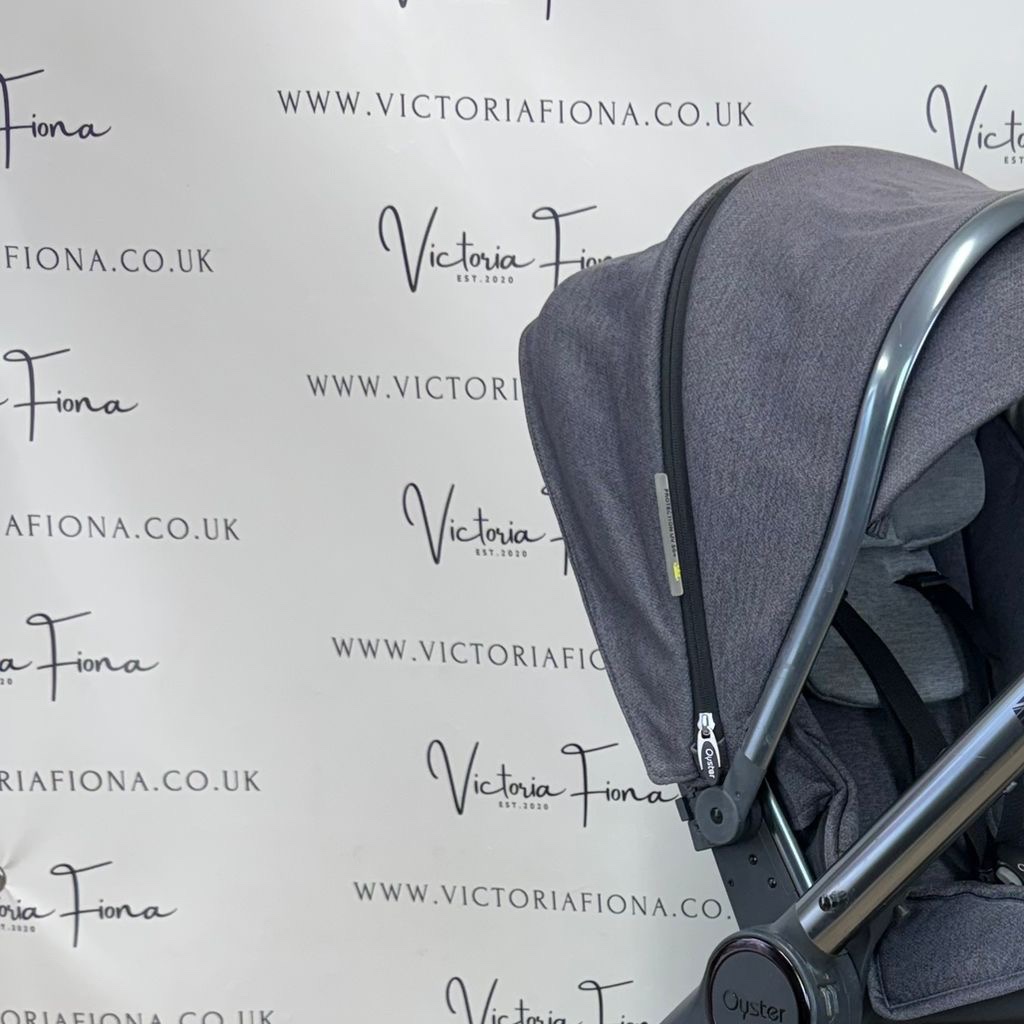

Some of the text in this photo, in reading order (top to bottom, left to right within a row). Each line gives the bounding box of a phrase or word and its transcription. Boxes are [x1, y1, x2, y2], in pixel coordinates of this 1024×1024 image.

[277, 90, 755, 127] WWW.VICTORIAFIONA.CO.UK
[379, 205, 535, 293] Victoria
[3, 348, 138, 442] Fiona
[402, 483, 546, 565] Victoria
[26, 611, 159, 701] Fiona
[427, 740, 681, 827] Victoria Fiona
[705, 749, 716, 779] Oyster
[50, 861, 178, 948] Fiona
[723, 990, 786, 1023] Oyster
